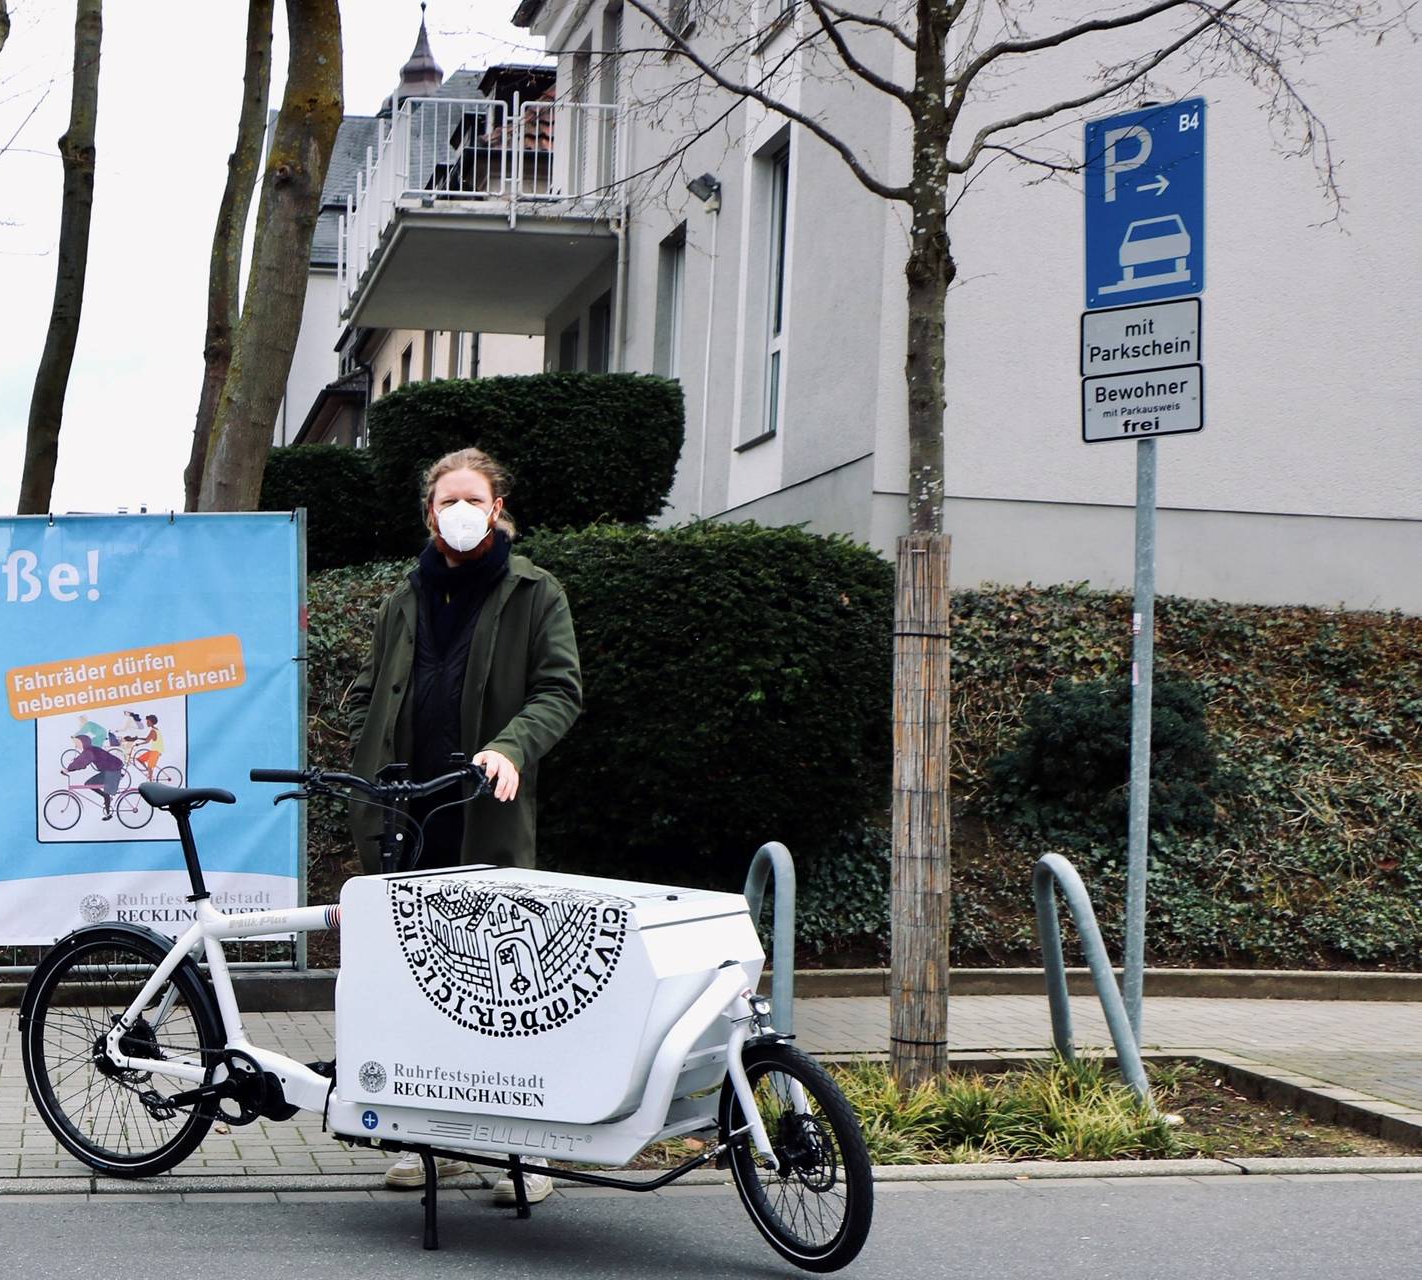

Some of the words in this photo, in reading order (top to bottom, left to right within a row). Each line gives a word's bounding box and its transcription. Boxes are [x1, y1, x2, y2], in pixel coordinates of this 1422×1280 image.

[1179, 112, 1199, 132] B4
[1104, 125, 1153, 203] P
[1125, 319, 1154, 337] mit
[1089, 337, 1191, 363] Parkschein
[1095, 380, 1188, 403] Bewohner
[1102, 409, 1118, 418] mit
[1120, 402, 1181, 417] Parkausweis
[1123, 417, 1160, 433] frei
[13, 662, 107, 692] Fahrräder
[112, 653, 176, 677] dürfen
[16, 677, 163, 714] nebeneinander
[167, 663, 238, 691] fahren!
[394, 1063, 545, 1089] Ruhrfestspielstadt
[393, 1081, 545, 1108] RECKLINGHAUSEN
